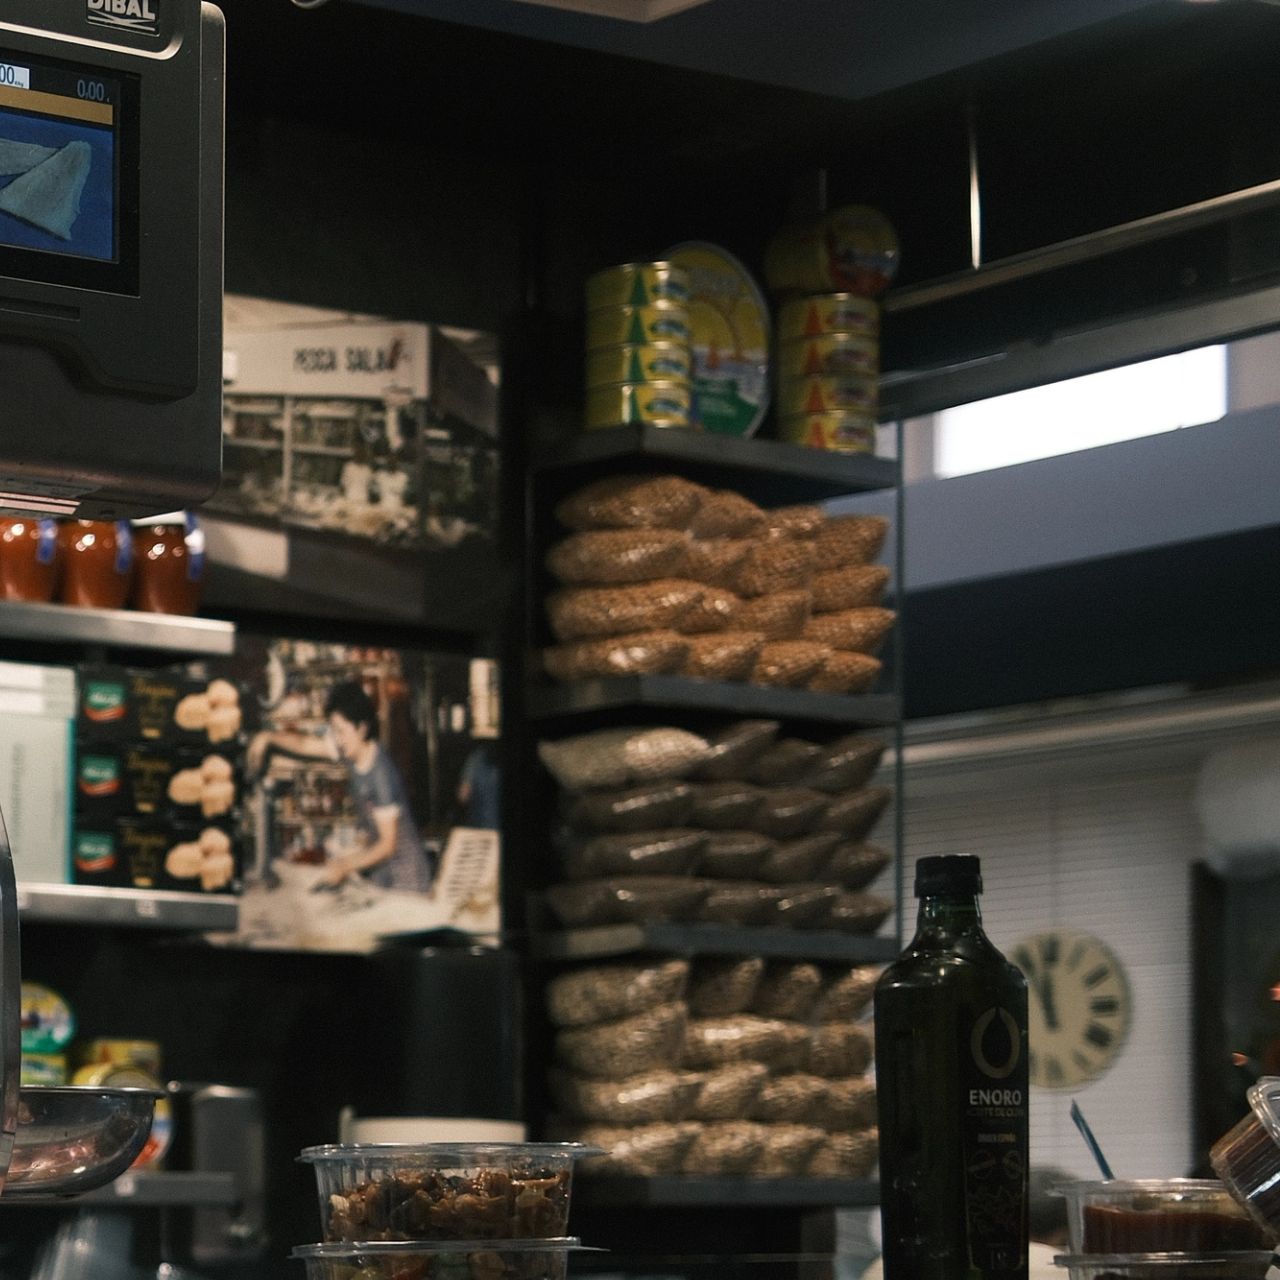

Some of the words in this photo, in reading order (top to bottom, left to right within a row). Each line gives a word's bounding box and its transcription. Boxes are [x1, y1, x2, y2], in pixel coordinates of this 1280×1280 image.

[88, 0, 156, 20] DIBAL
[77, 79, 104, 101] 0,00
[969, 1089, 1022, 1106] ENORO
